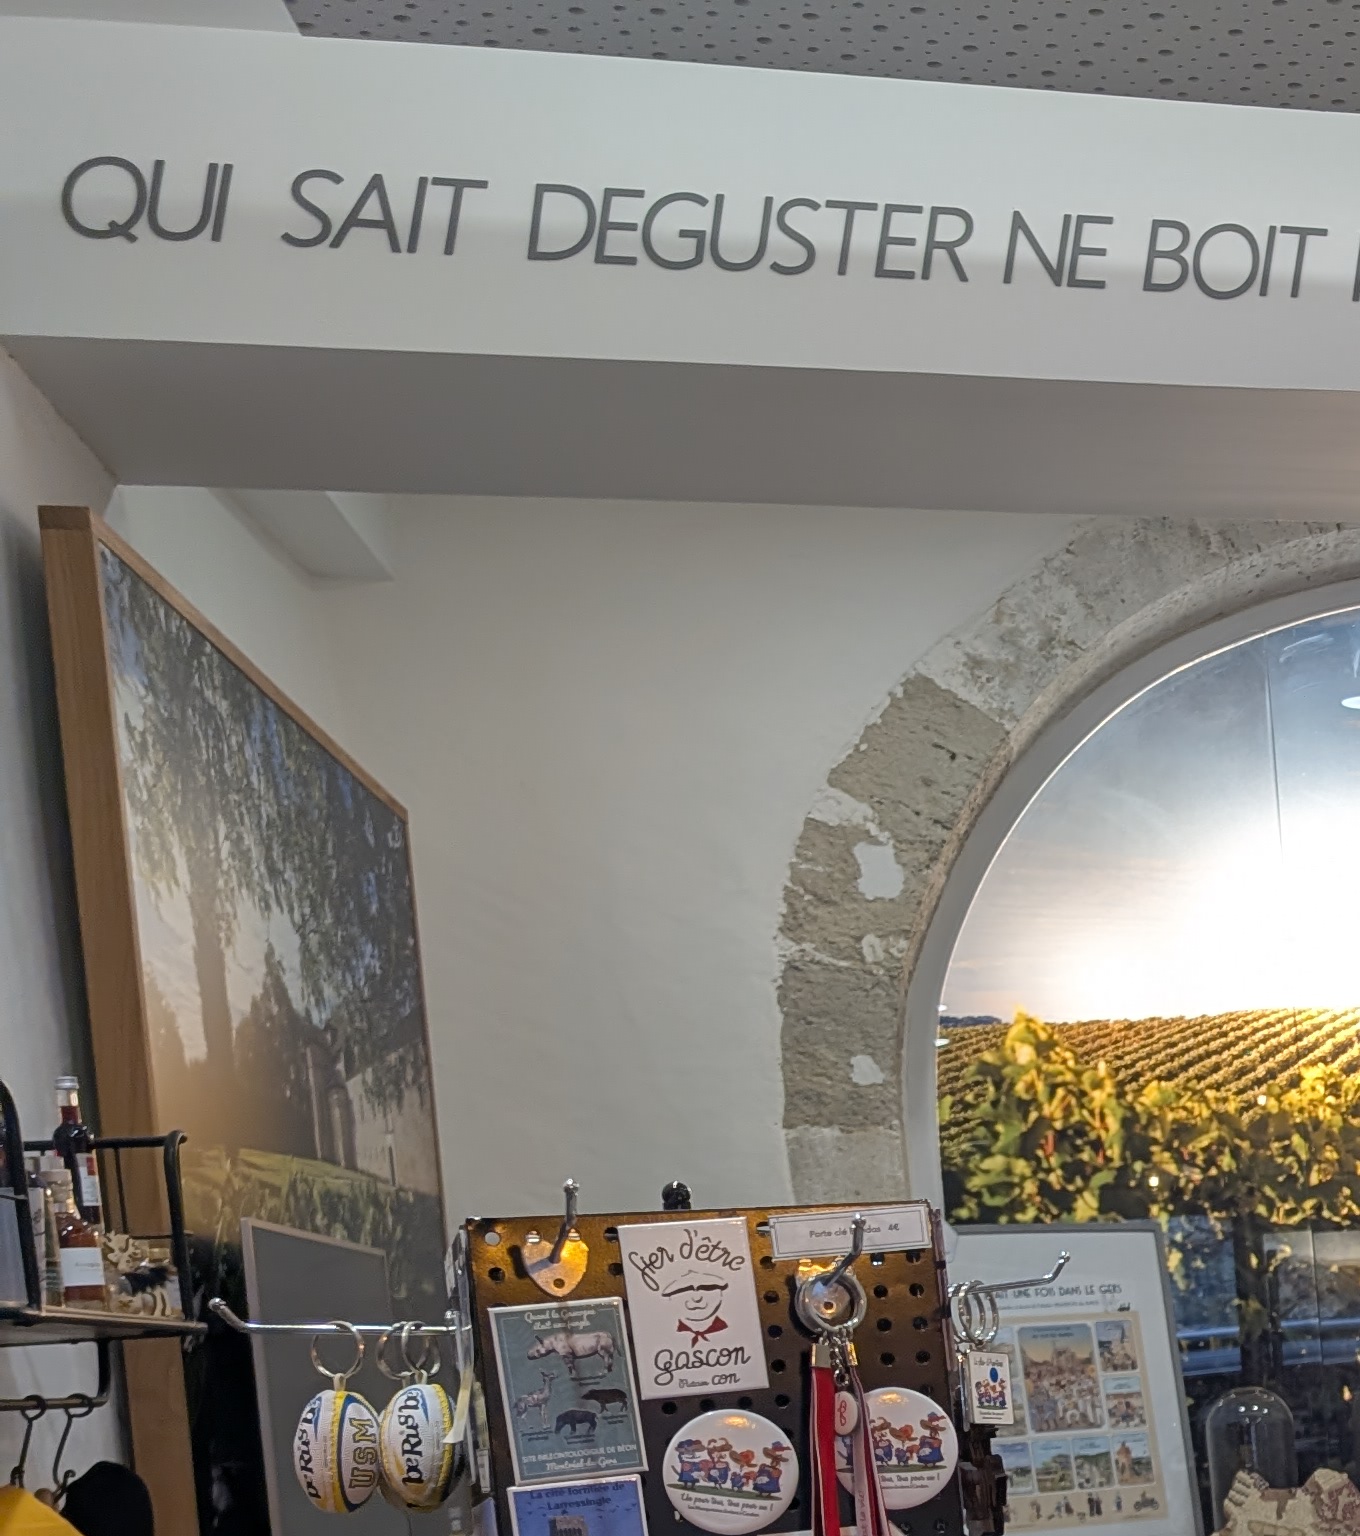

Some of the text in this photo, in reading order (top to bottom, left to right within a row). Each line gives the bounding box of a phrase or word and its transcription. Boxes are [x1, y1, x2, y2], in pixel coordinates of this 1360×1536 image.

[61, 156, 232, 243] QUI
[281, 170, 488, 255] SAIT
[525, 182, 974, 283] DEGUSTER
[1003, 211, 1113, 290] NE
[1143, 217, 1329, 299] BOIT
[679, 1228, 746, 1272] d'être
[711, 1371, 741, 1385] con
[349, 1418, 378, 1489] USM
